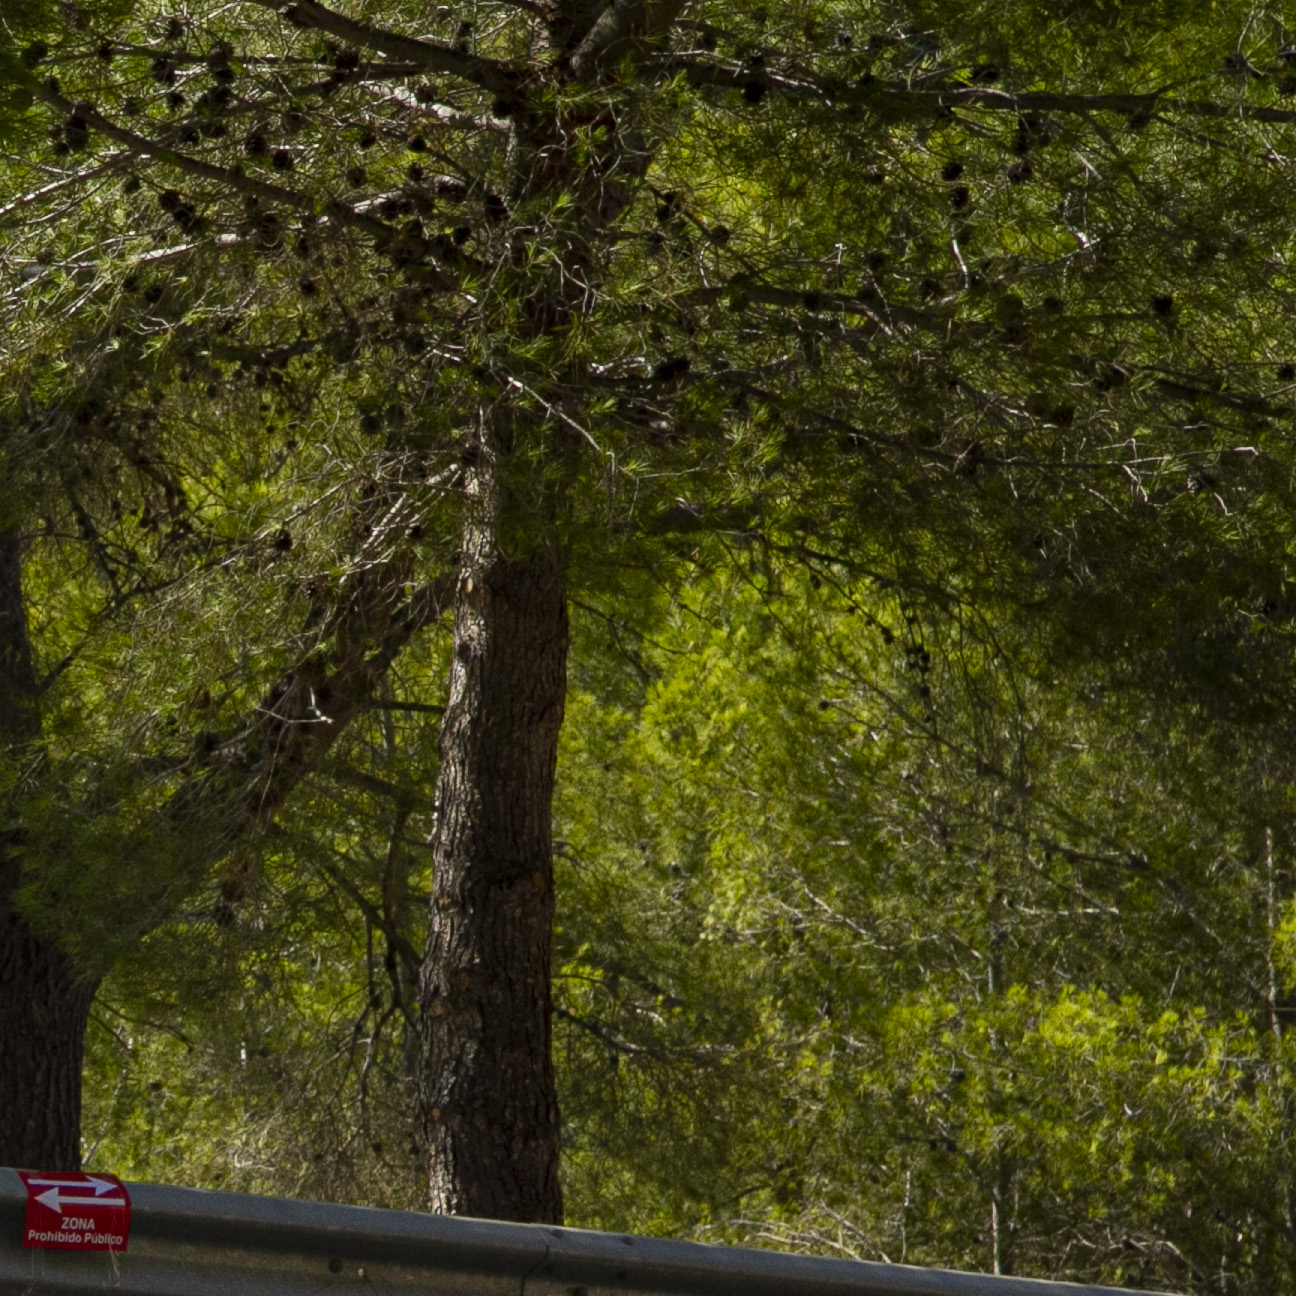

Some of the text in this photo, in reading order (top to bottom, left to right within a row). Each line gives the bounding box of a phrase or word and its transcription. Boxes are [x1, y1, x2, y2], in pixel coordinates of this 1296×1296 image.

[61, 1217, 95, 1230] ZONA
[28, 1229, 124, 1245] Prohibido Público
